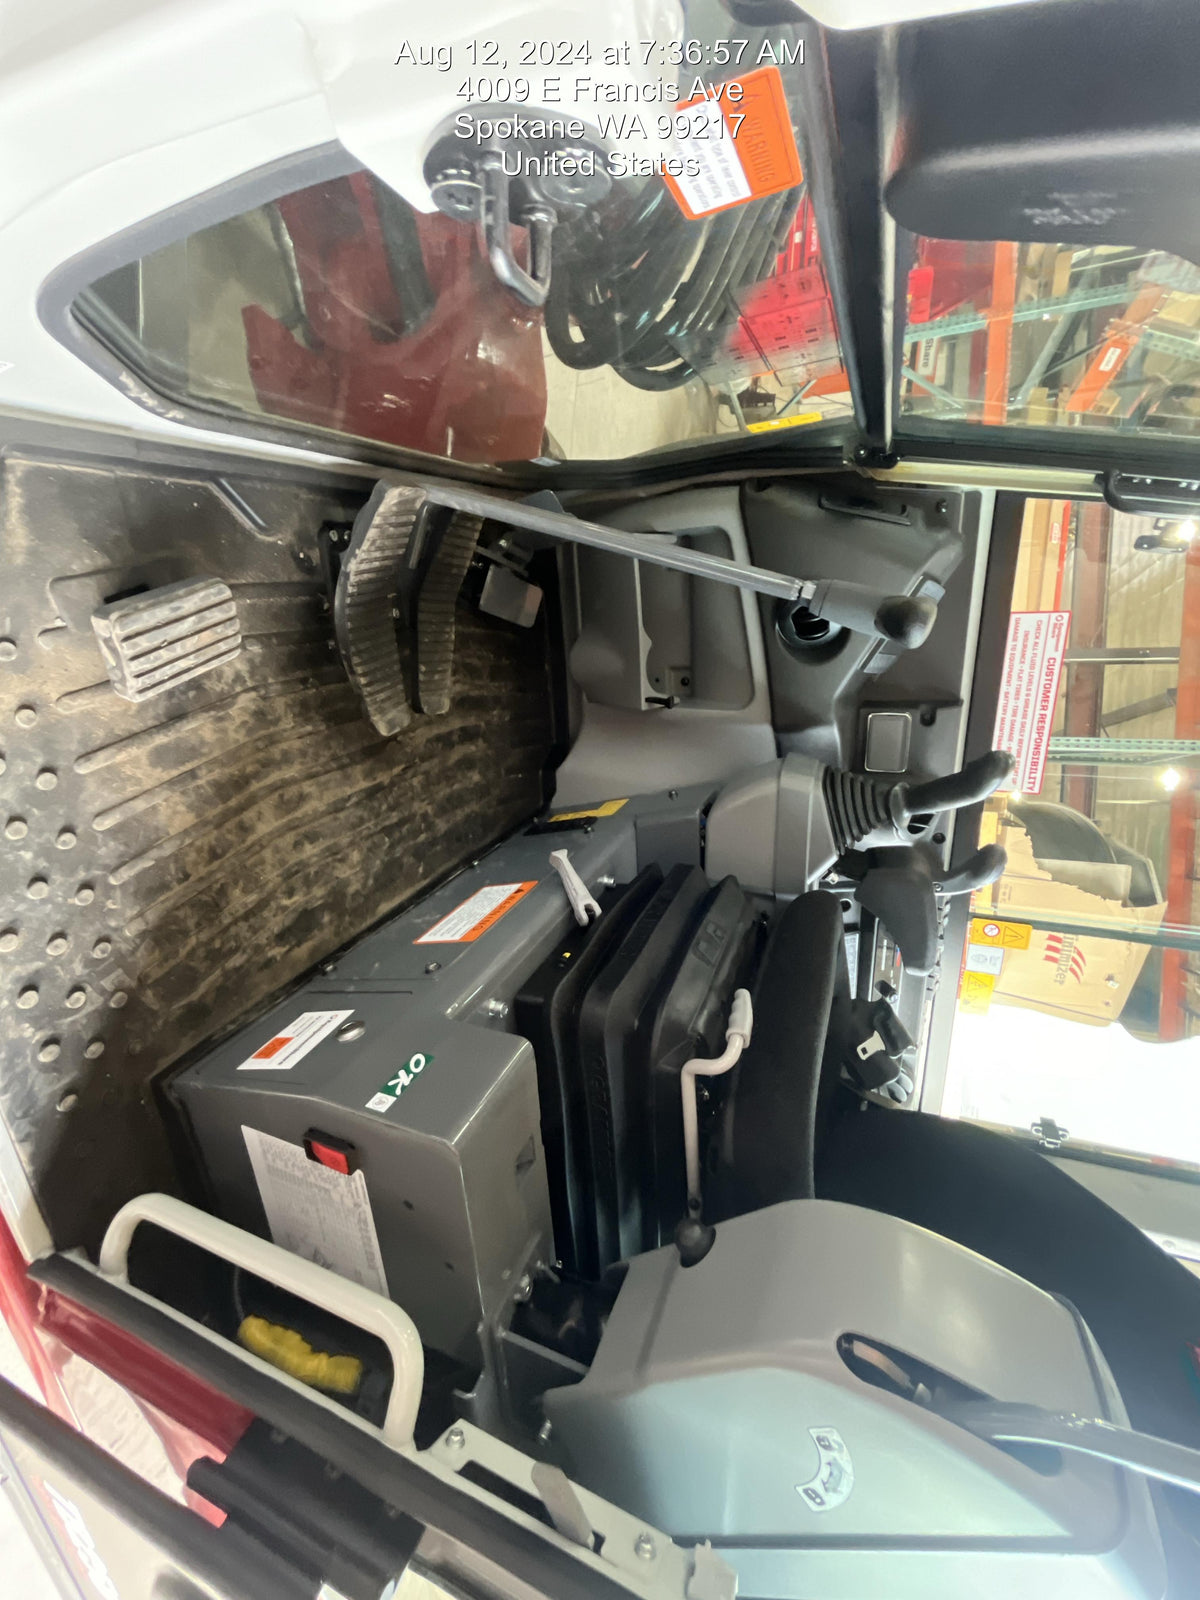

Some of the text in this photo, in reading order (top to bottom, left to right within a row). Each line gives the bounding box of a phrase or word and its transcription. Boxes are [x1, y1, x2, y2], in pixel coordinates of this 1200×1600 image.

[743, 117, 776, 183] WARNING
[1035, 619, 1043, 640] CHECK
[1020, 630, 1030, 664] INSURANCE
[1032, 641, 1040, 651] ALL
[1029, 652, 1037, 671] FLUID
[996, 617, 1021, 750] DAMAGE TO EQUIPMENT BATTERY MAINTENAN
[1017, 669, 1025, 682] FLAT
[1026, 671, 1035, 692] LEVELS
[1023, 698, 1031, 720] GREASE
[1007, 719, 1016, 742] DAMAGE
[1019, 720, 1027, 737] DAILY
[1027, 657, 1056, 791] CUSTOMER RESPONSIBILITY
[1016, 738, 1024, 758] BEFORE
[1054, 934, 1079, 985] inimizer
[387, 1052, 426, 1096] OK
